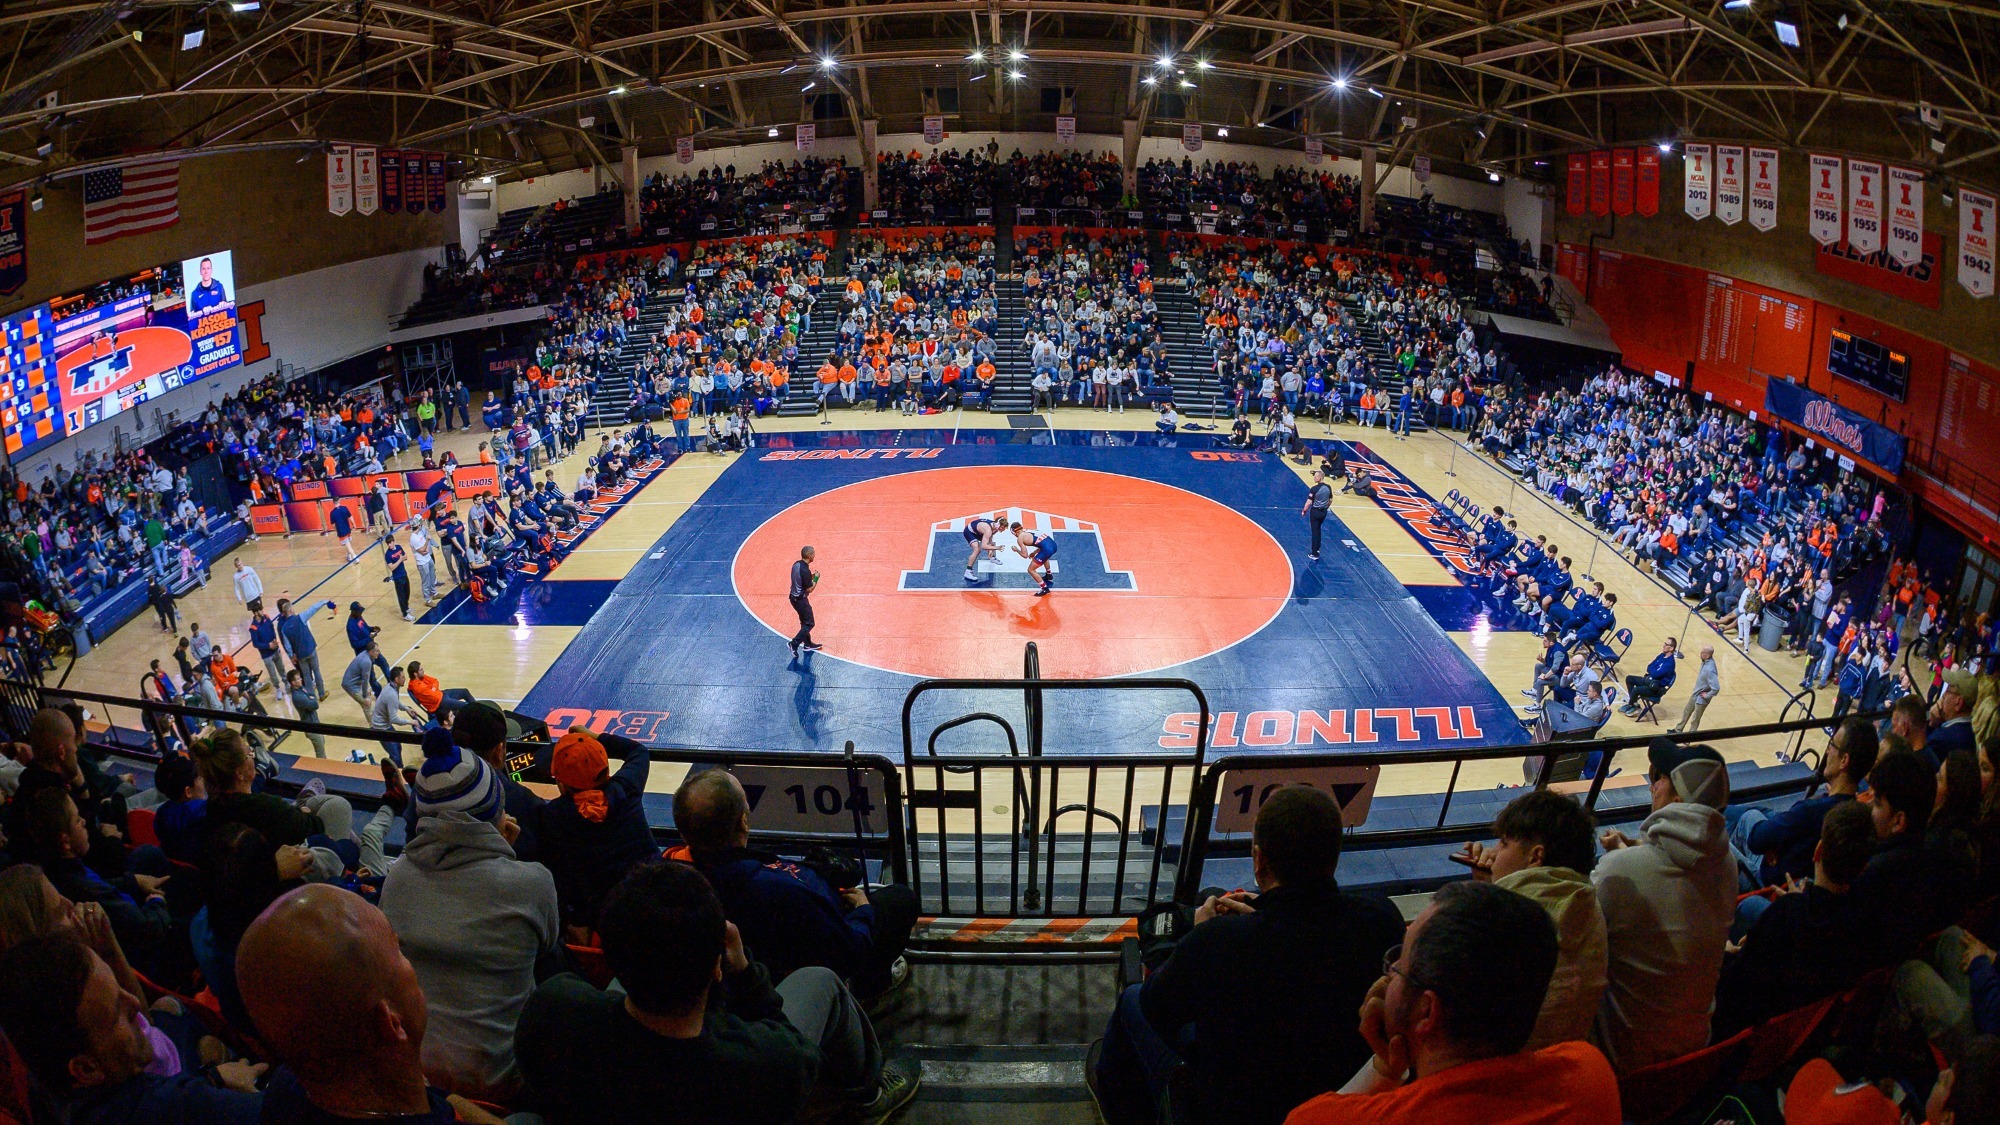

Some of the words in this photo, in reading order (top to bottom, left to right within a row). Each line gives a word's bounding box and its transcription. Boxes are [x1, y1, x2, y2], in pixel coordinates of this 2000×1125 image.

[1688, 145, 1709, 153] ILLINOIS
[1719, 147, 1741, 155] ILLINOIS
[1752, 150, 1776, 159] ILLINOIS
[1813, 157, 1839, 167] ILLINOIS
[1851, 163, 1879, 174] ILLINOIS
[1690, 174, 1705, 182] NCAA
[1722, 178, 1737, 186] NCAA
[1891, 170, 1920, 182] ILLINOIS
[1755, 182, 1772, 190] NCAA
[1689, 190, 1707, 200] 2012
[1720, 194, 1740, 205] 1989
[1816, 191, 1835, 201] NCAA
[1962, 193, 1993, 208] ILLINOIS
[1753, 199, 1774, 210] 1958
[1855, 199, 1874, 209] NCAA
[1813, 209, 1837, 223] 1956
[1895, 208, 1915, 219] NCAA
[1853, 217, 1877, 232] 1955
[1892, 226, 1919, 243] 1950
[1966, 233, 1987, 247] NCAA
[1963, 254, 1991, 274] 1942
[198, 311, 228, 329] JASON
[10, 328, 19, 341] T
[190, 318, 236, 340] KRAISSER
[237, 299, 271, 367] I
[213, 330, 232, 347] 157
[14, 353, 21, 365] 1
[199, 345, 236, 365] GRADUATE
[16, 378, 25, 391] 9
[164, 374, 180, 389] 12
[2, 385, 10, 398] 2
[18, 402, 31, 417] 15
[89, 408, 98, 423] 3
[5, 410, 14, 423] 4
[1803, 400, 1863, 453] Illinois
[759, 448, 945, 461] ILLINOIS
[296, 481, 321, 492] ILLINOIS
[458, 477, 493, 488] ILLINOIS
[255, 514, 279, 524] ILLINOIS
[1158, 706, 1483, 748] ILLINOIS
[784, 784, 876, 816] 104
